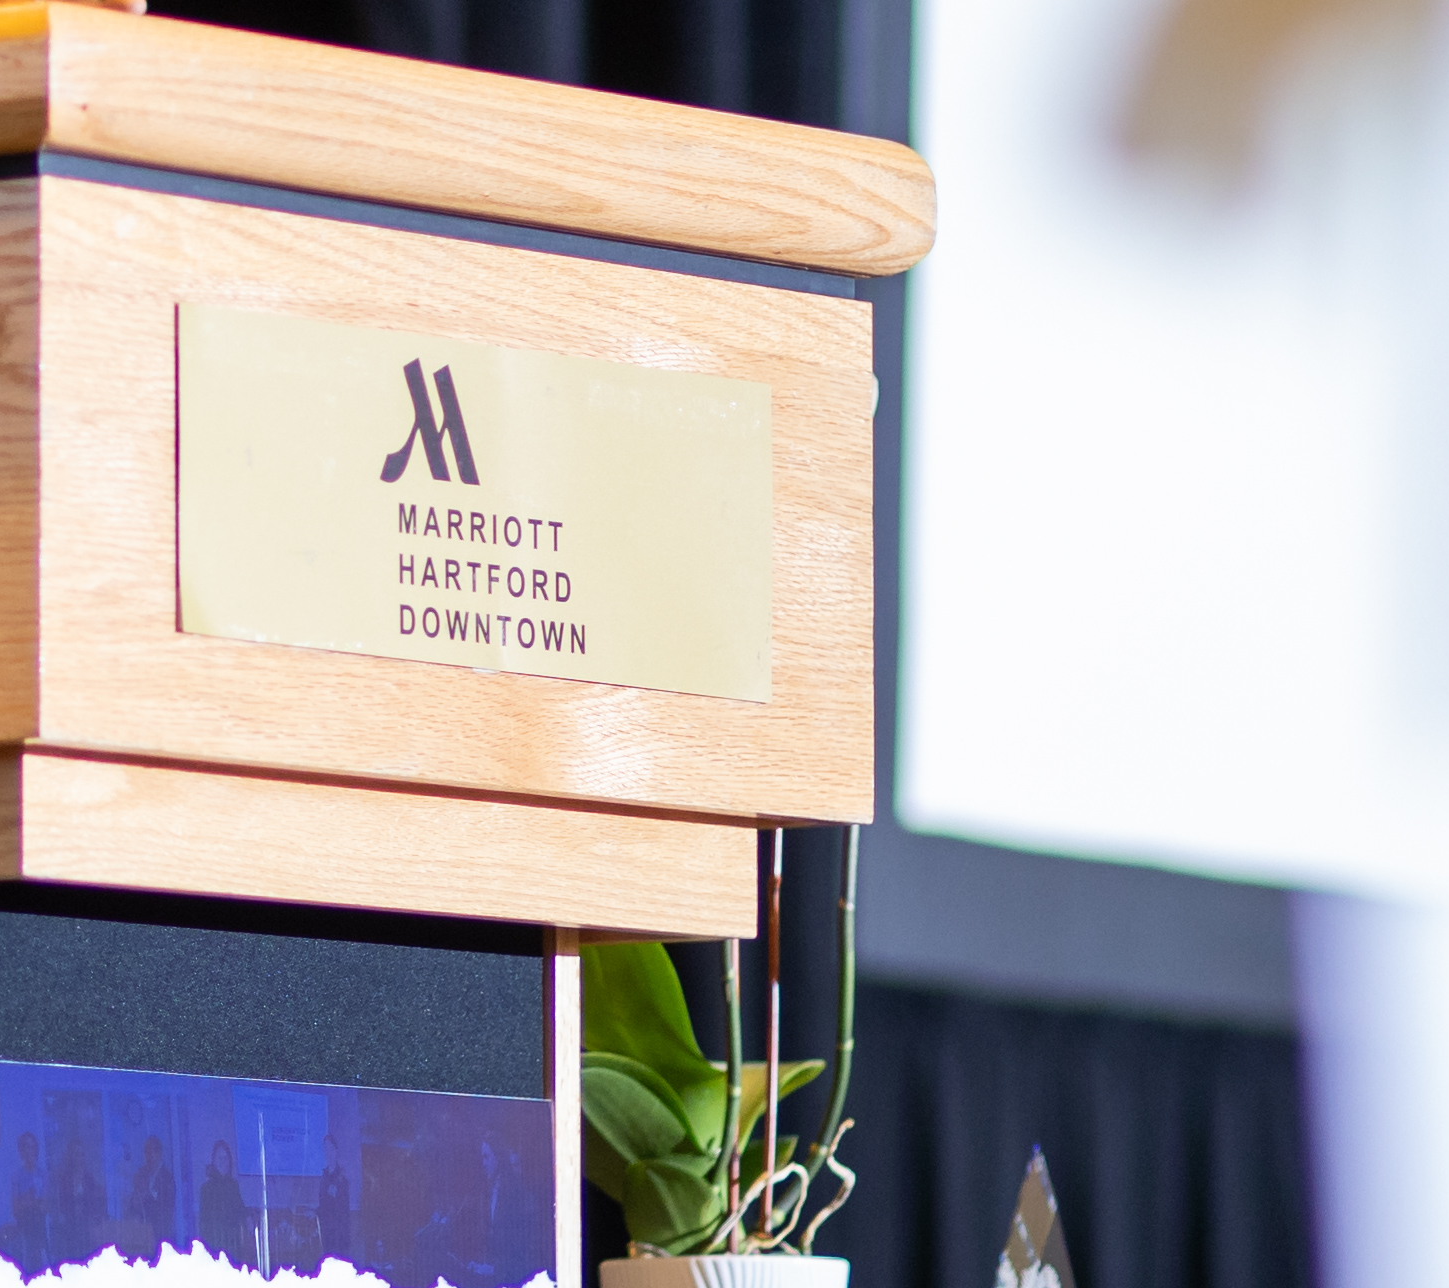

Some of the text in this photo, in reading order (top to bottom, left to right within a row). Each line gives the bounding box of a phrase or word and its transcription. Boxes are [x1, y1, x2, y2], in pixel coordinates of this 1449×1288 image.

[398, 502, 563, 552] MARRIOTT
[399, 553, 572, 603] HARTFORD
[399, 603, 586, 655] DOWNTOWN
